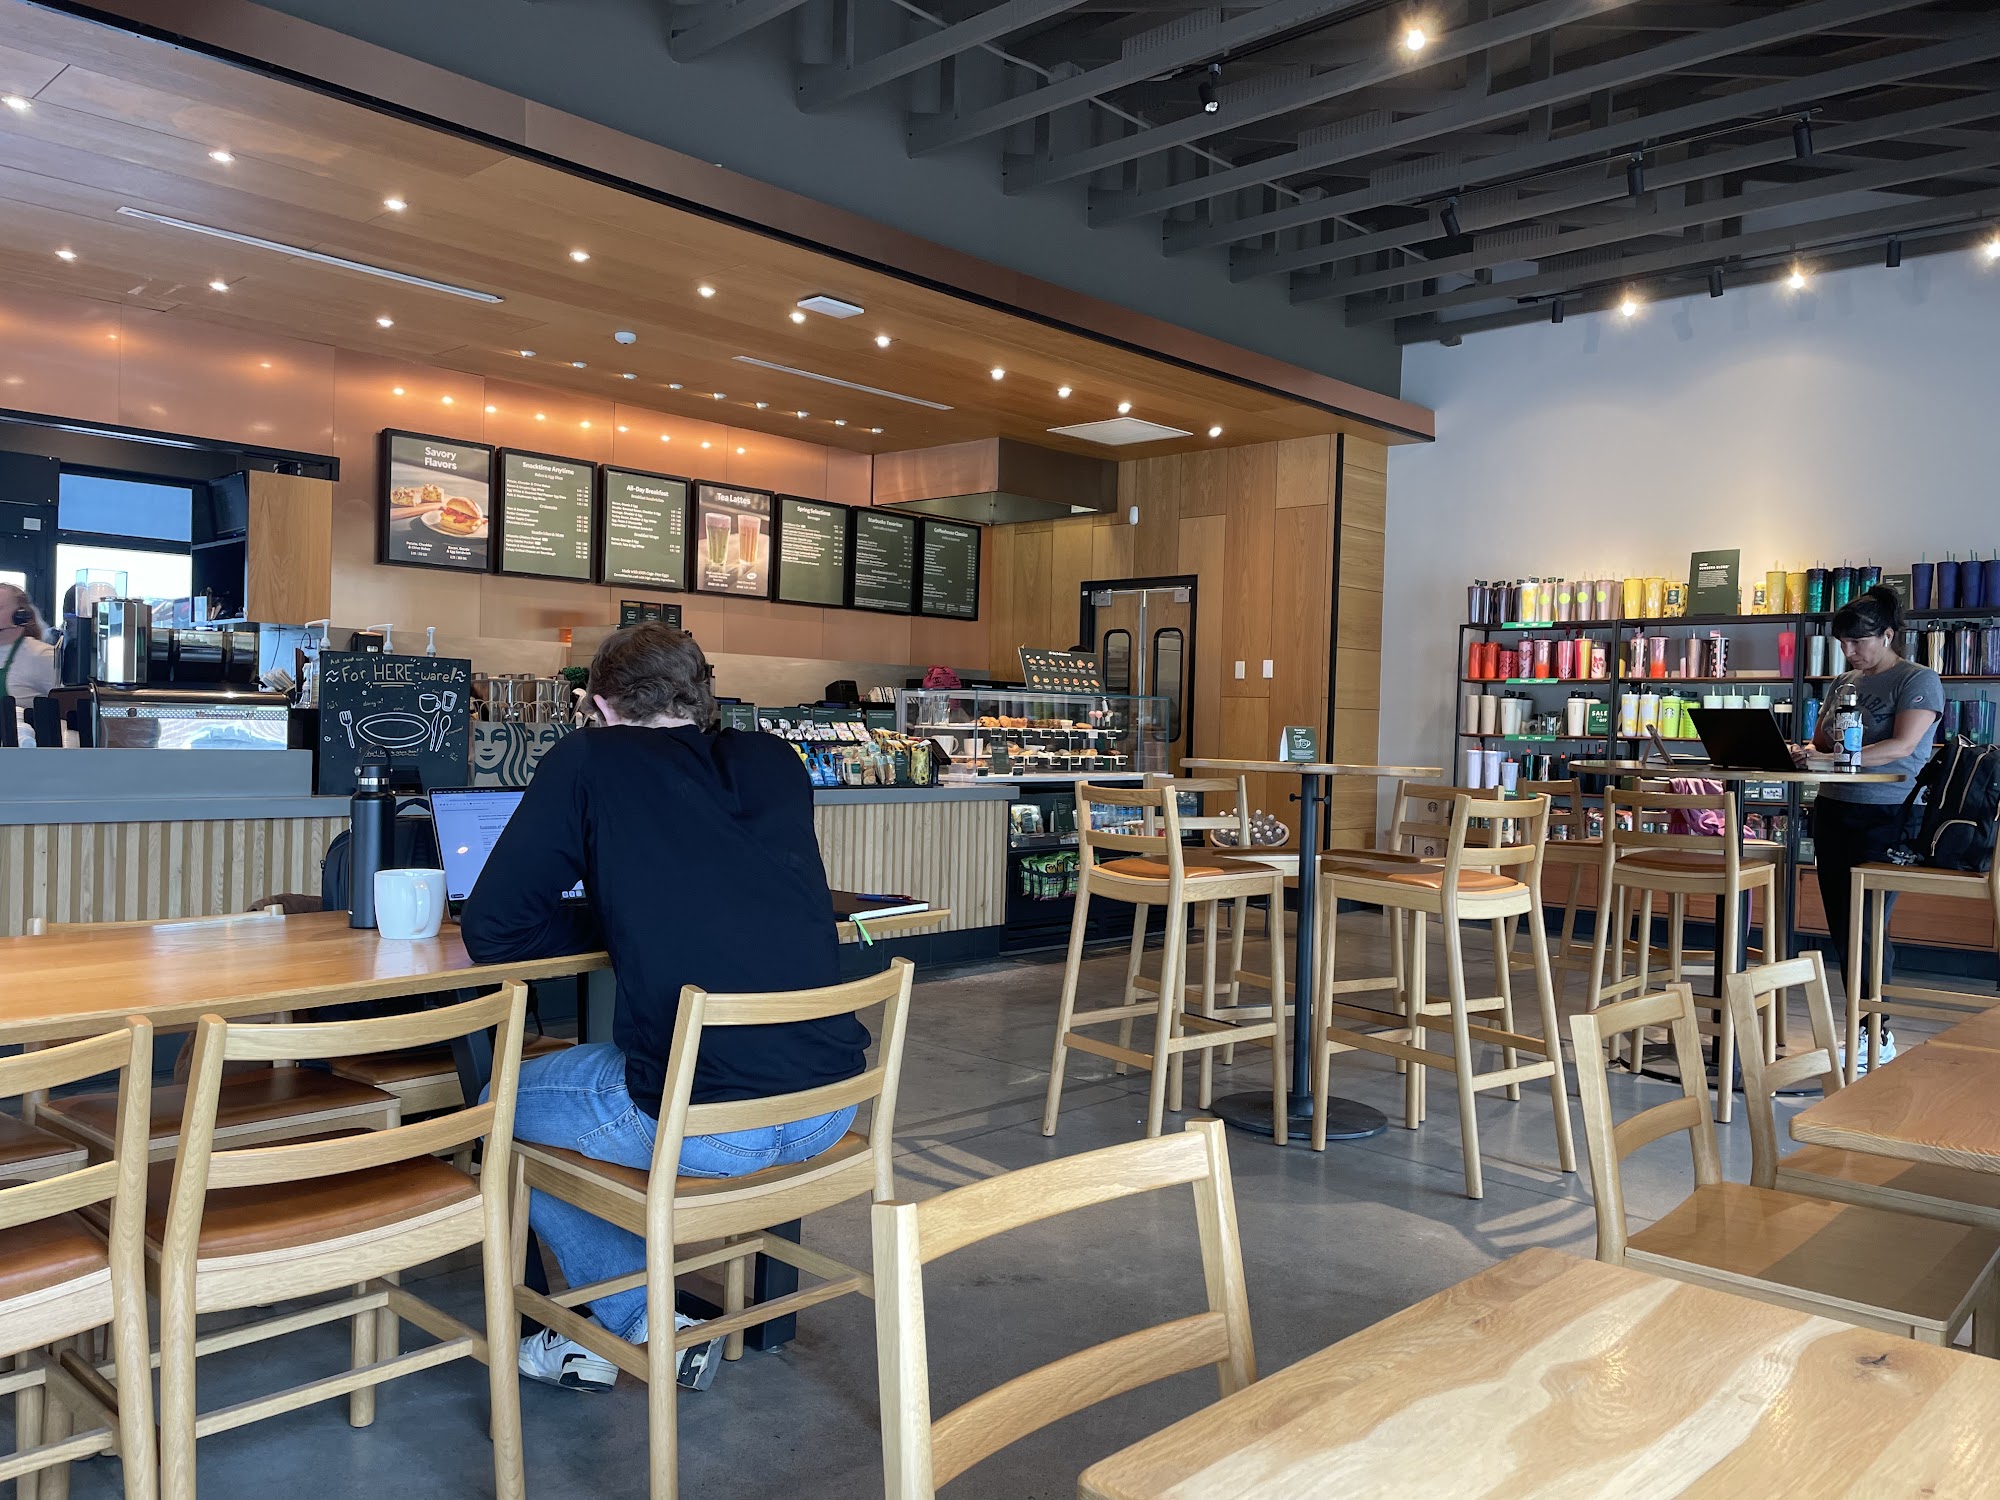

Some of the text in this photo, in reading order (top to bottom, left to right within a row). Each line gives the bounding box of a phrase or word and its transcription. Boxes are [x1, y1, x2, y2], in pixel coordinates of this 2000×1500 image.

[425, 447, 456, 460] Savory
[424, 457, 457, 470] Flavors
[523, 462, 575, 475] Snacktime Anytime
[627, 485, 669, 497] All-Day Breakfast
[717, 493, 751, 505] Tea Lattes
[342, 665, 366, 682] For
